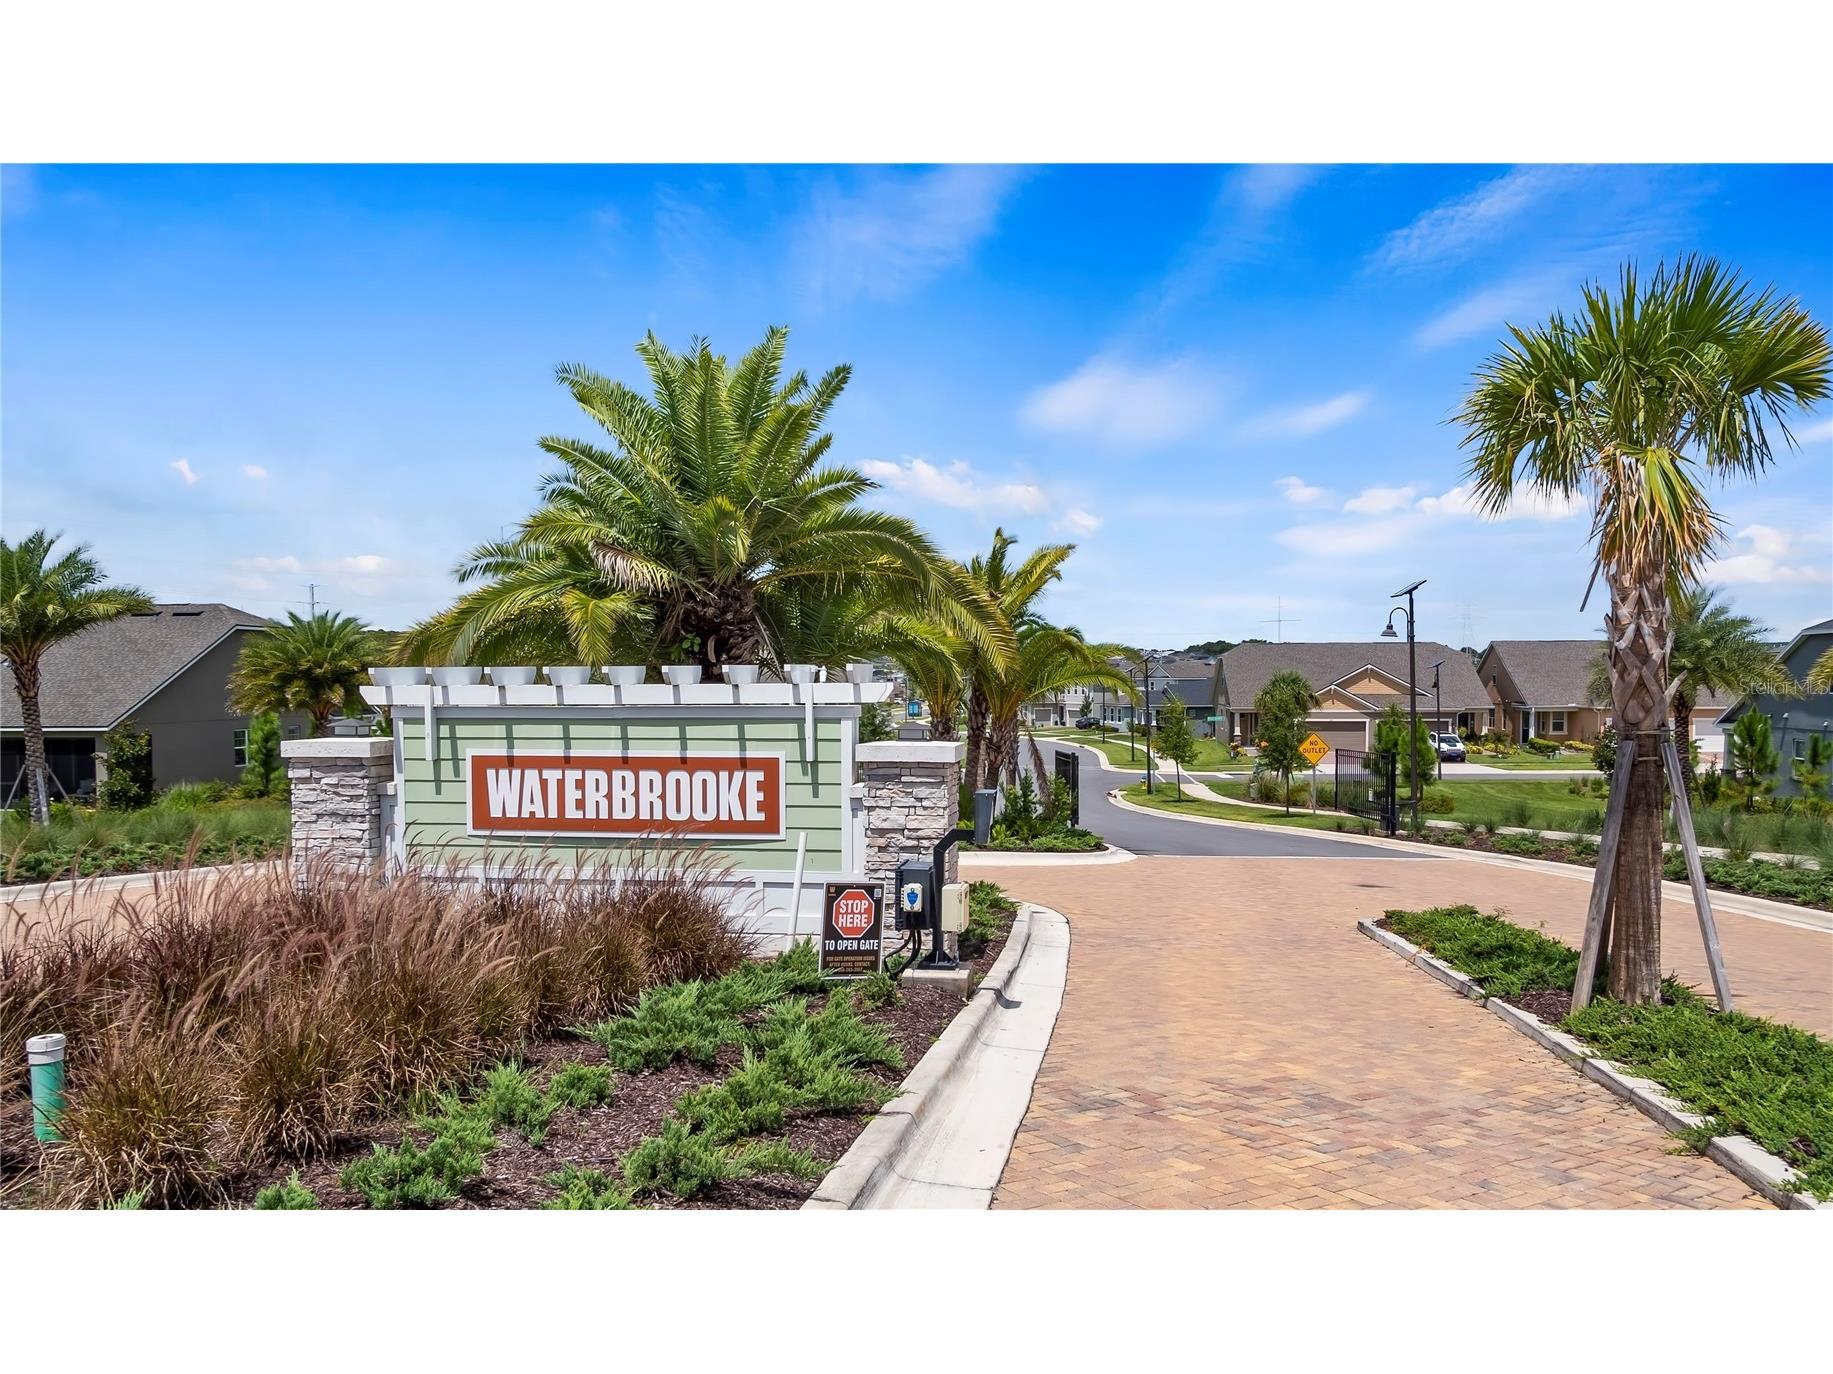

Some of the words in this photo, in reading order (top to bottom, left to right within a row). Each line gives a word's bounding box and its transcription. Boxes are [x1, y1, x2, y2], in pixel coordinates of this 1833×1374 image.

[486, 768, 766, 822] WATERBROOKE
[839, 899, 869, 914] STOP
[838, 914, 869, 928] HERE
[824, 940, 836, 951] TO
[837, 940, 858, 951] OPEN
[860, 939, 879, 950] GATE
